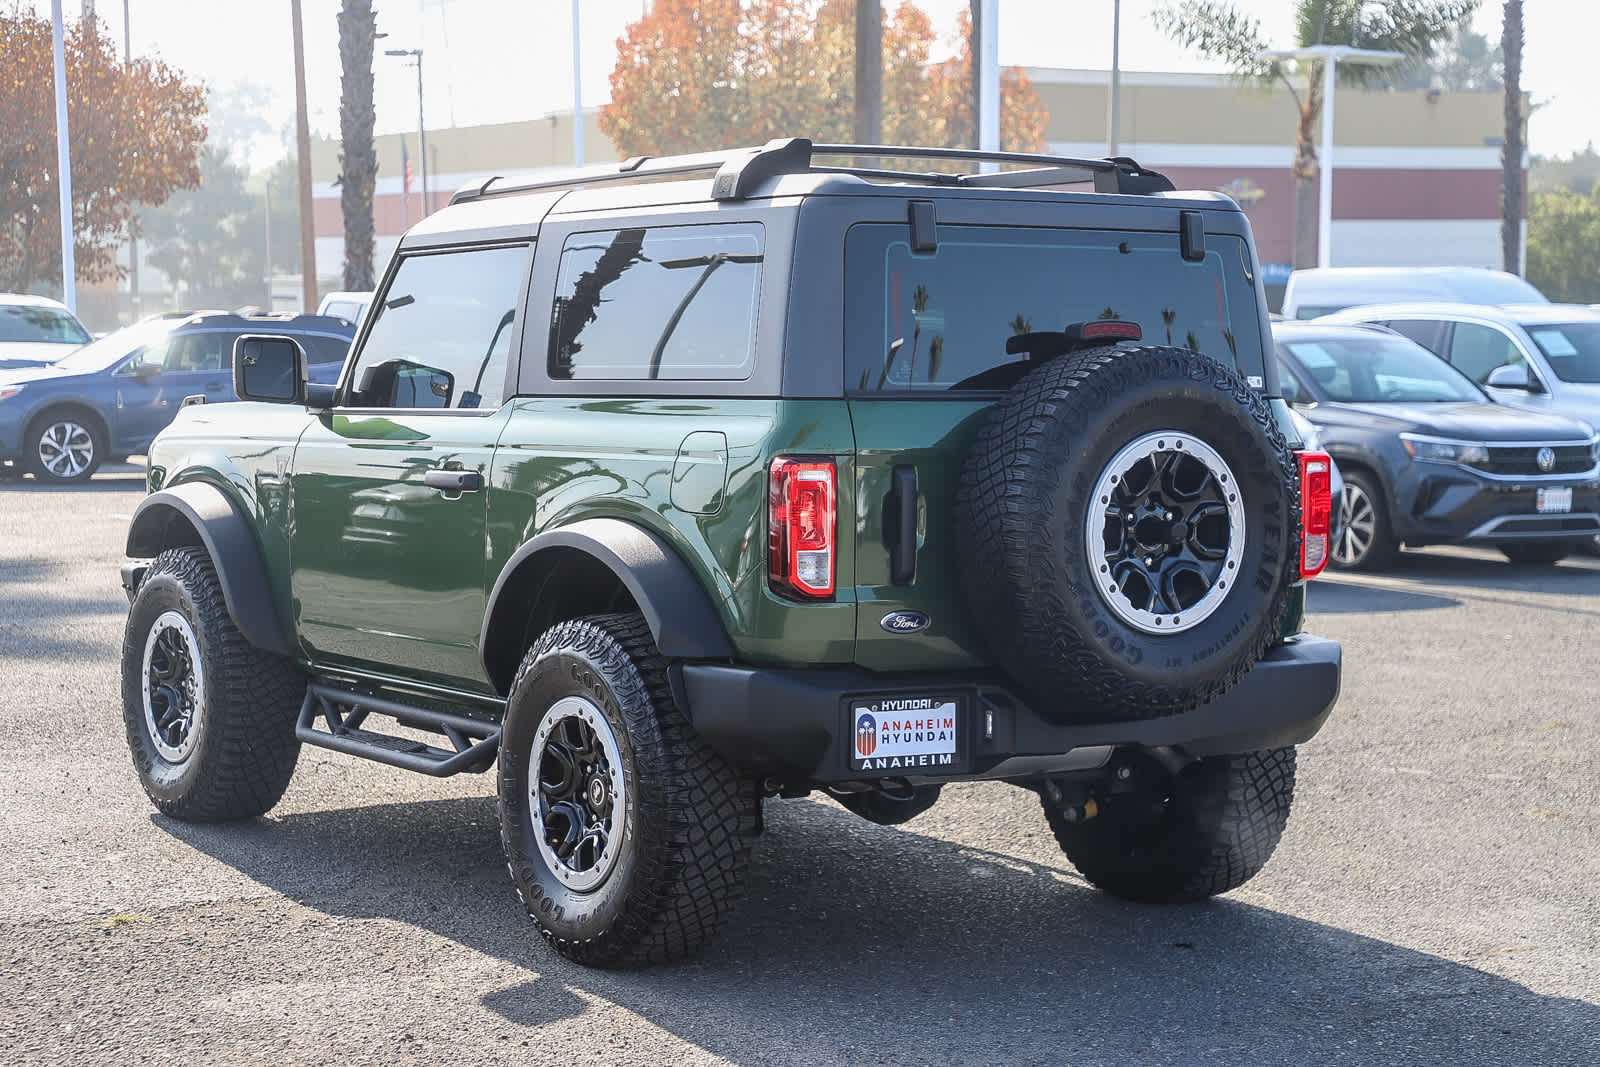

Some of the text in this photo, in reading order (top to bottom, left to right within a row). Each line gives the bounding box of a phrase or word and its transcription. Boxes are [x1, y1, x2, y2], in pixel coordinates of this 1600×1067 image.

[892, 615, 920, 628] Ford
[881, 699, 931, 711] HYUNDAI
[881, 718, 953, 732] ANAHEIM
[881, 731, 953, 744] HYUNDAI
[862, 754, 952, 770] ANAHEIM
